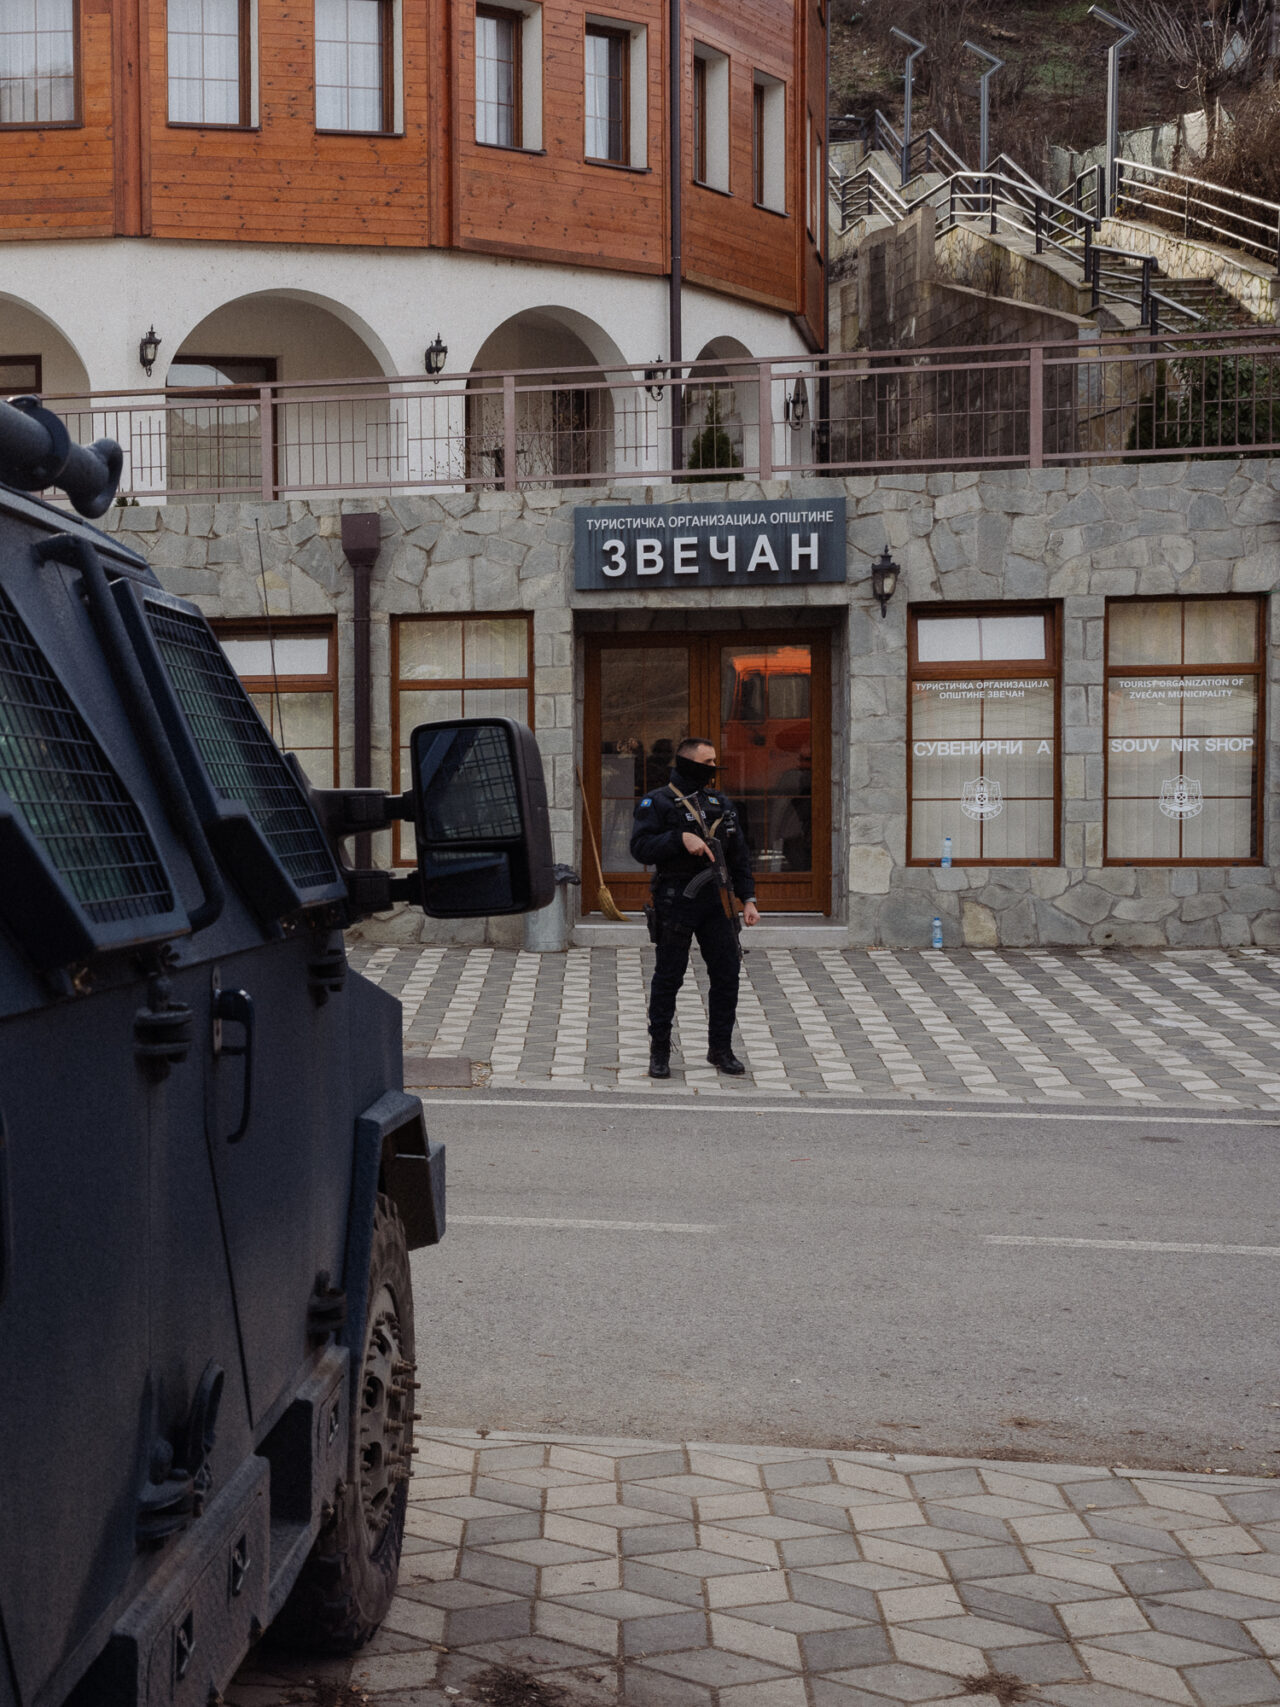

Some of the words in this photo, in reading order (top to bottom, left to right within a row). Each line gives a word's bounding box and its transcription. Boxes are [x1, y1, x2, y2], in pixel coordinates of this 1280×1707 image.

[586, 517, 666, 530] ТУРИСТИЧКА
[668, 513, 767, 528] ОРГАНИЗАЦИЈА
[770, 510, 834, 525] ОПШТИНЕ
[601, 532, 819, 577] ЗВЕЧАН
[915, 682, 974, 691] ТУРИСТИЧКА
[976, 680, 1050, 690] ОРГАНИЗАЦИЈА
[1119, 680, 1157, 689] TOURIST
[1159, 678, 1230, 688] ORGANIZATION
[1231, 678, 1245, 687] OF
[939, 691, 985, 700] ОПШТИНЕ
[987, 690, 1025, 699] ЗВЕЧАН
[1129, 689, 1166, 700] ZVEČAN
[1167, 689, 1233, 699] MUNICIPALITY
[1205, 737, 1254, 752] SHOP
